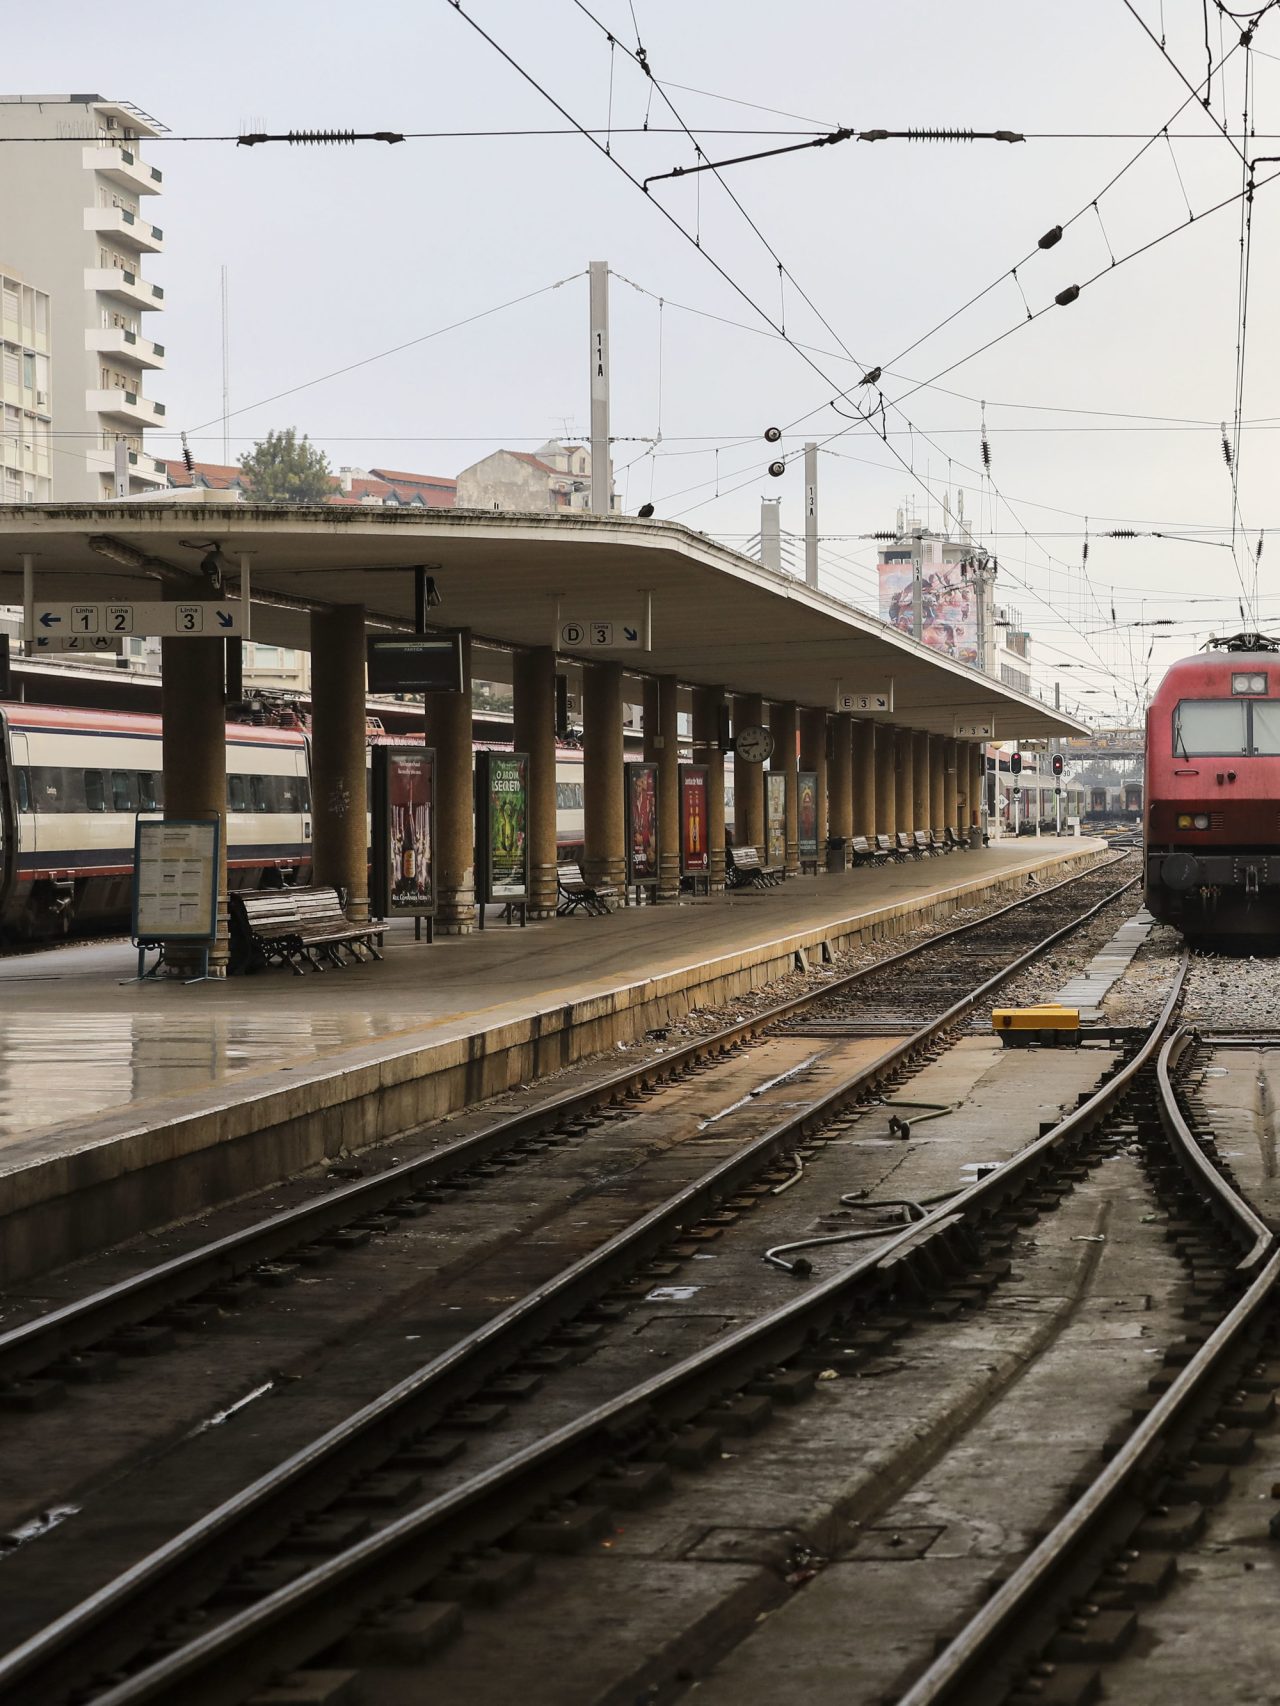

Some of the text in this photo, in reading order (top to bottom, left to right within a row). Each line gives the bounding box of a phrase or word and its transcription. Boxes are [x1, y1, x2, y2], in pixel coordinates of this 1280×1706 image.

[80, 614, 126, 630] 1 2
[184, 614, 195, 630] 3
[568, 628, 606, 643] D 3
[844, 698, 867, 708] E 3
[496, 770, 502, 779] O
